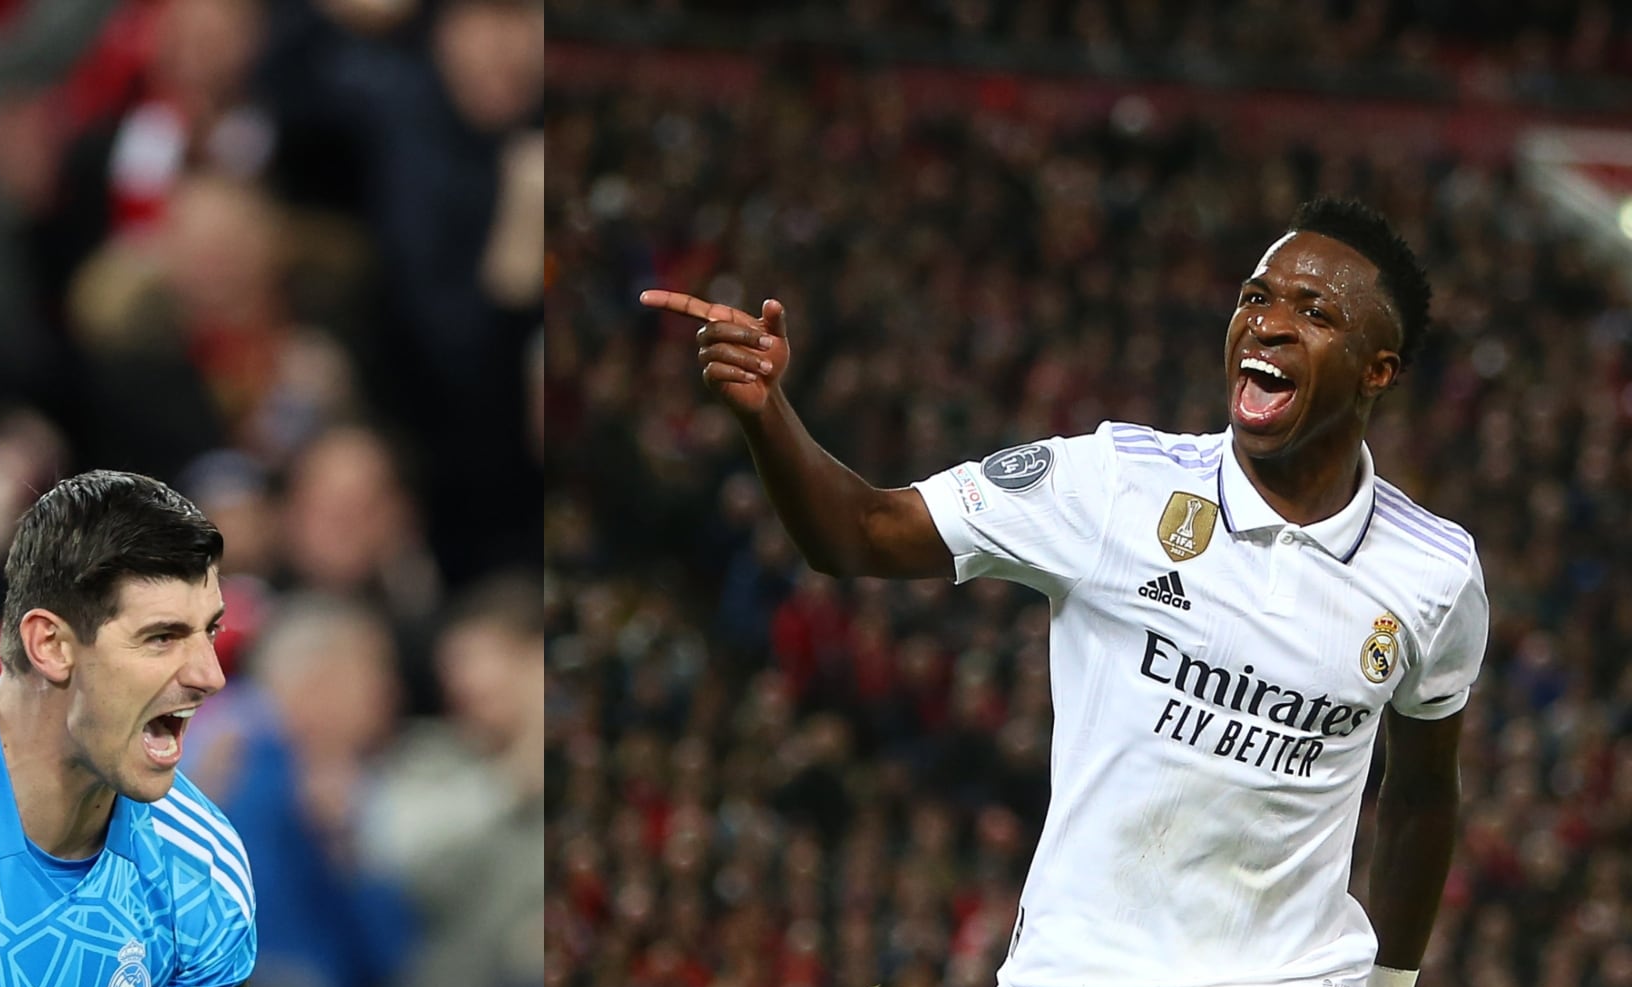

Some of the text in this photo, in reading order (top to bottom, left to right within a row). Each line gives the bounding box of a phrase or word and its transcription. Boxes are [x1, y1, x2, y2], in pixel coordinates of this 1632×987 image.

[1169, 533, 1196, 550] FIFA
[1138, 586, 1191, 611] adidas
[1140, 629, 1371, 737] Emirates
[1153, 699, 1324, 778] FLY BETTER
